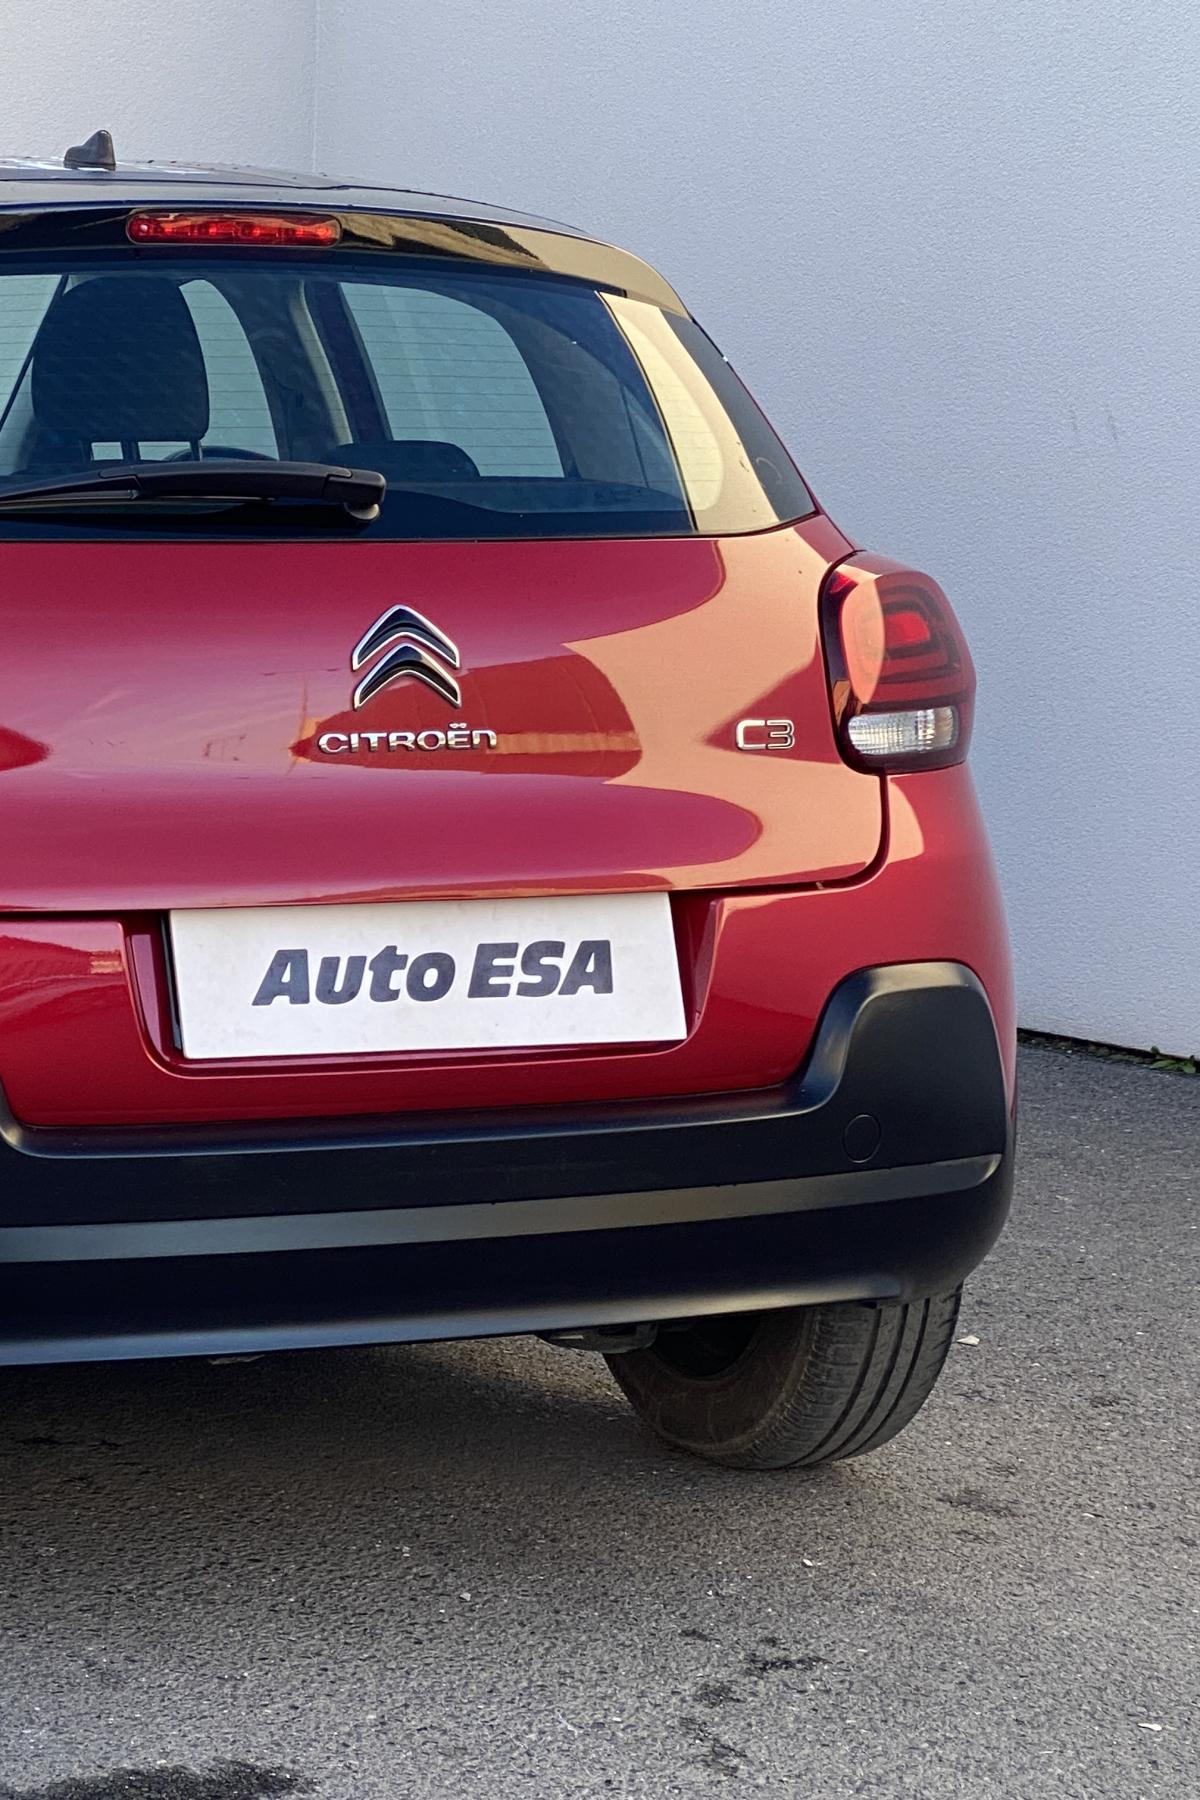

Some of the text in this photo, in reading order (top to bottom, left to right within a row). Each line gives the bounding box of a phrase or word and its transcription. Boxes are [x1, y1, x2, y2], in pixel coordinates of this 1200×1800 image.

[736, 719, 795, 751] C3
[252, 939, 615, 1007] Auto ESA
